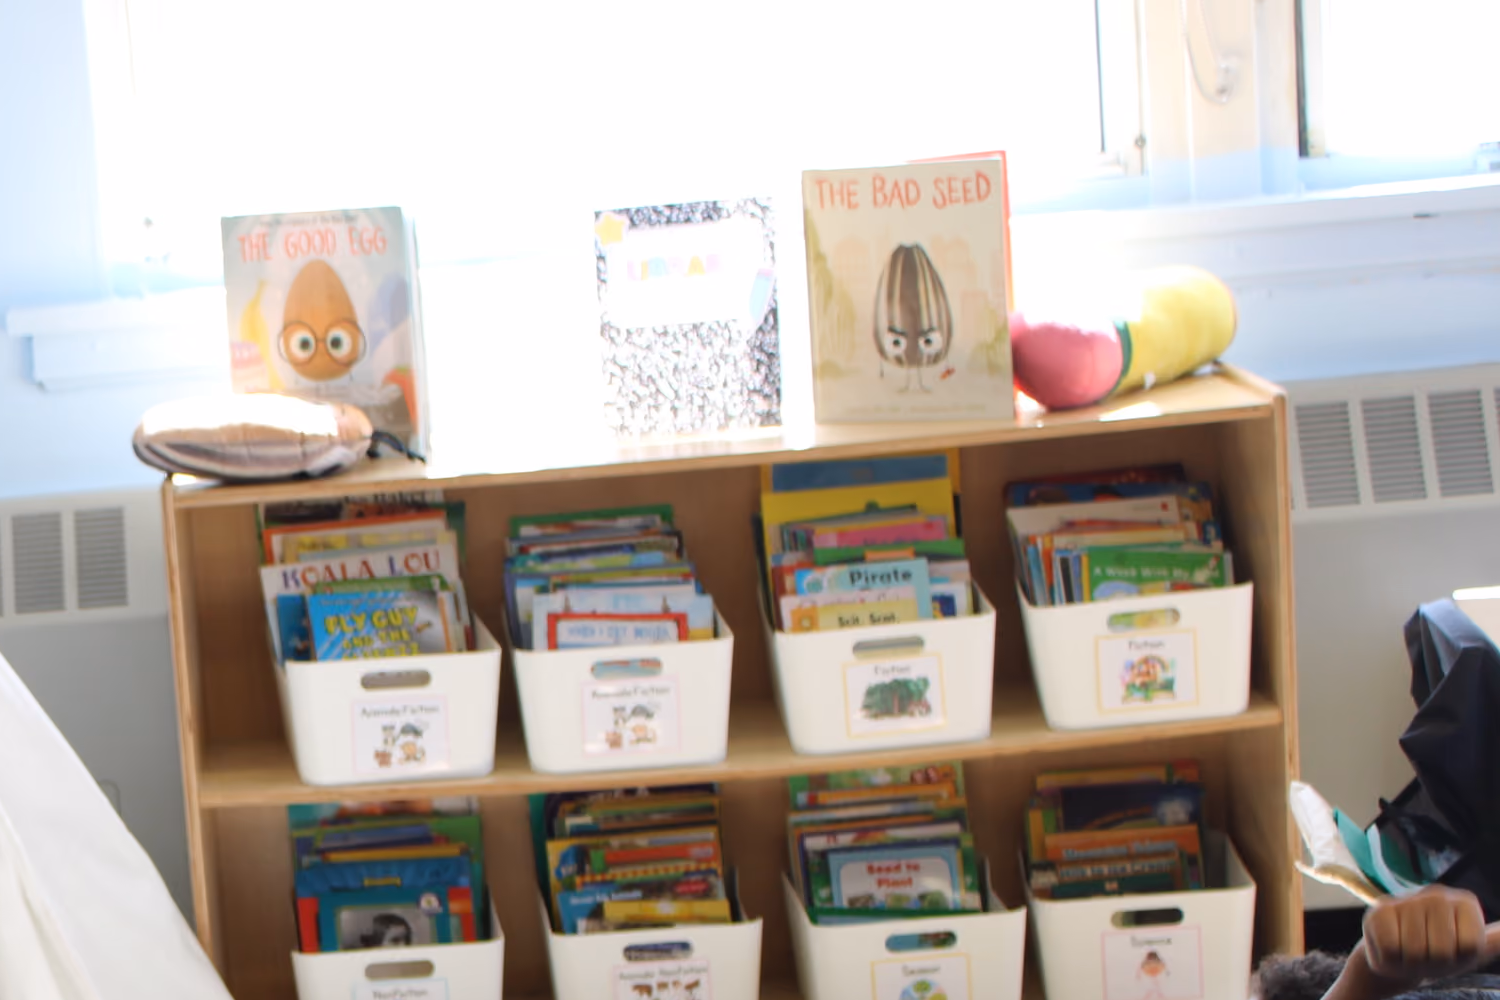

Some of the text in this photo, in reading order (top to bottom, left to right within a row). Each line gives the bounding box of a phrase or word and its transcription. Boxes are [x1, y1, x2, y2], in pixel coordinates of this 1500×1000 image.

[815, 170, 992, 210] THE BAD SEED
[237, 226, 387, 264] THE GOOD EGG
[282, 550, 439, 590] KOALA LOU
[849, 567, 913, 586] Pirate
[324, 606, 419, 635] FLY GUY
[378, 629, 411, 645] THE
